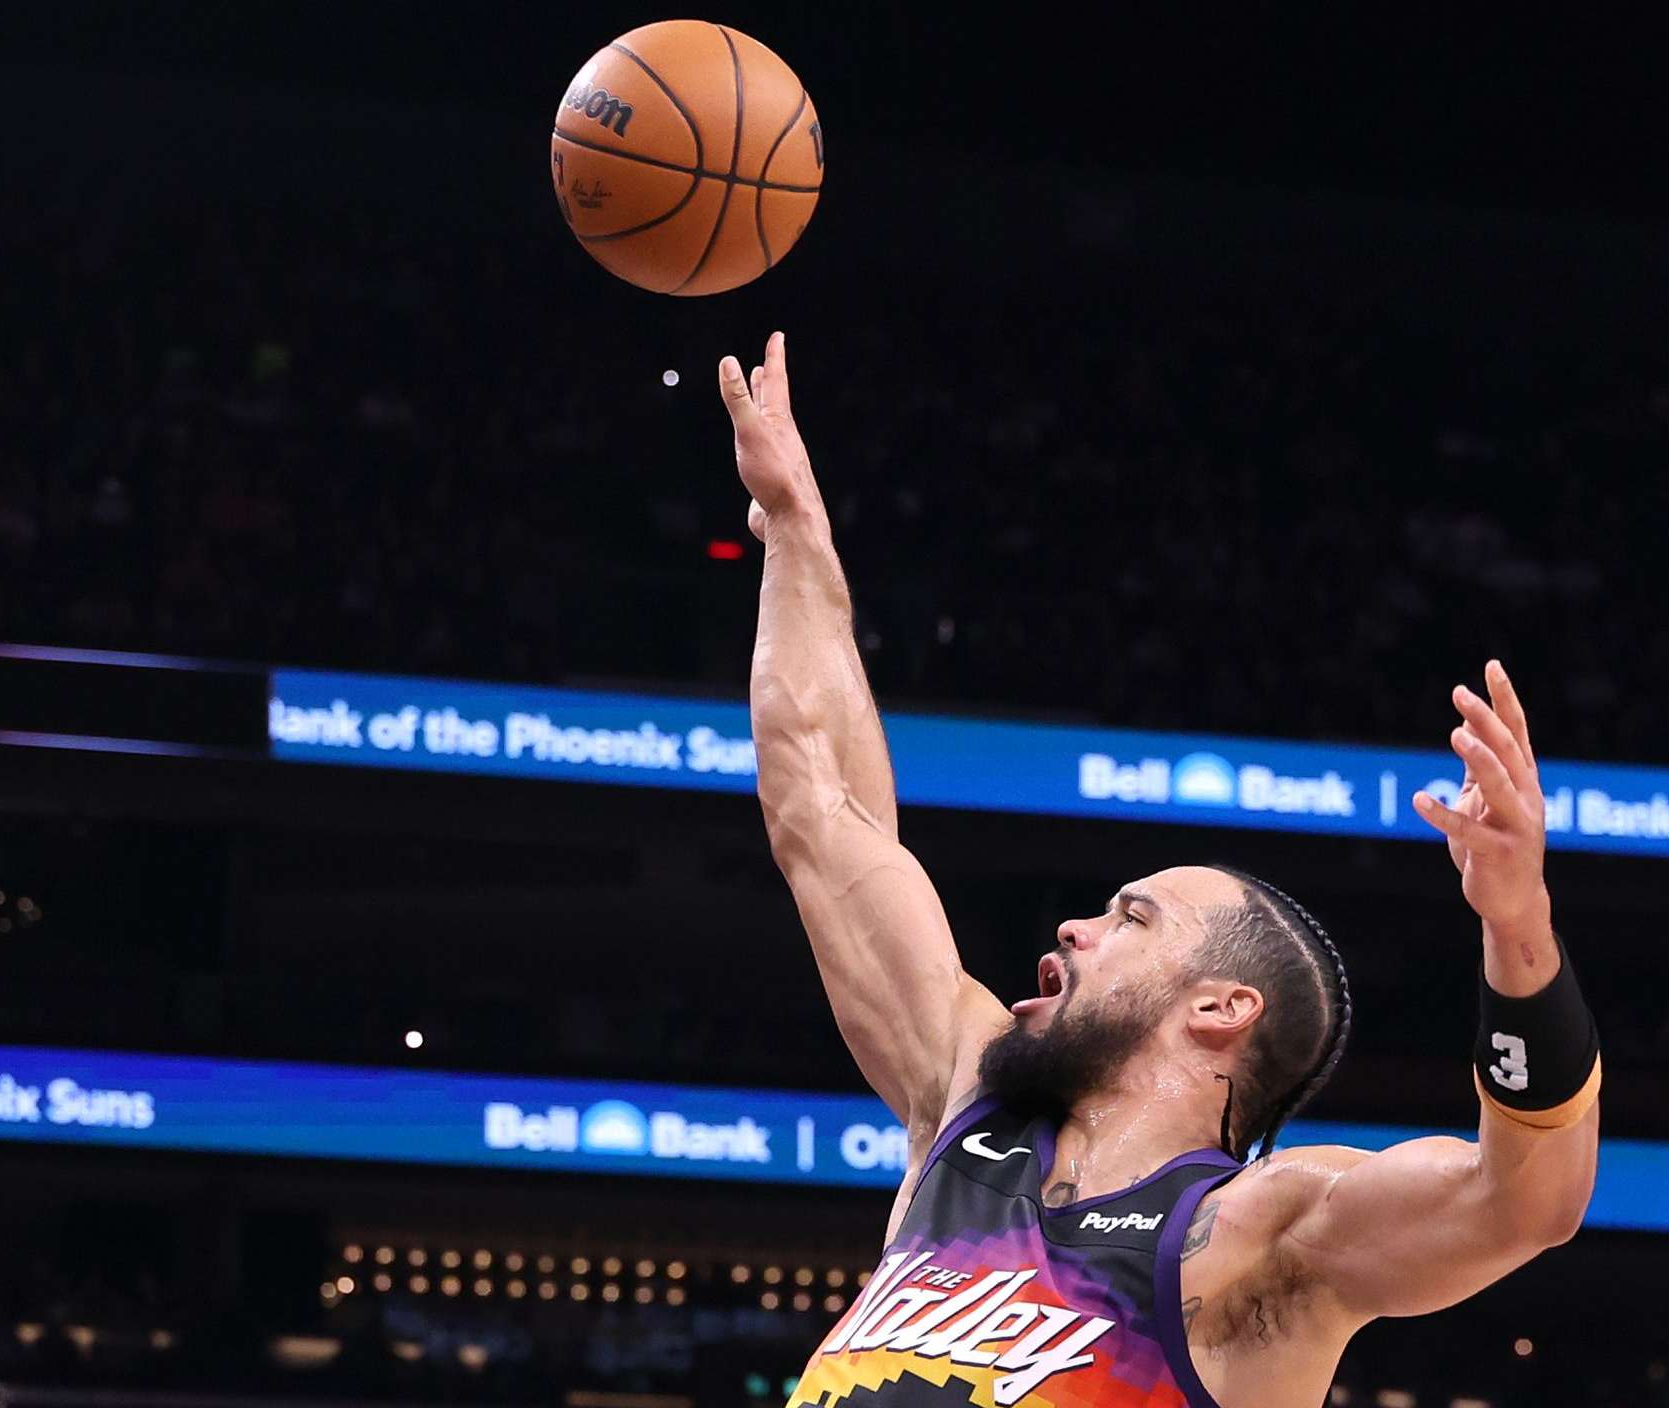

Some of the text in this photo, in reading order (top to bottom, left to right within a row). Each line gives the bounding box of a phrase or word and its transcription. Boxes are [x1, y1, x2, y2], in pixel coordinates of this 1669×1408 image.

[368, 706, 419, 750] of
[424, 710, 498, 756] the
[506, 713, 681, 768] Phoenix
[688, 728, 756, 774] Sun
[1079, 754, 1353, 815] Bell Bank
[1489, 1032, 1528, 1091] 3
[48, 1079, 154, 1128] Suns
[485, 1103, 769, 1162] Bell Bank
[1079, 1212, 1163, 1234] PayPal
[915, 1264, 971, 1291] THE
[824, 1251, 1115, 1406] Valley
